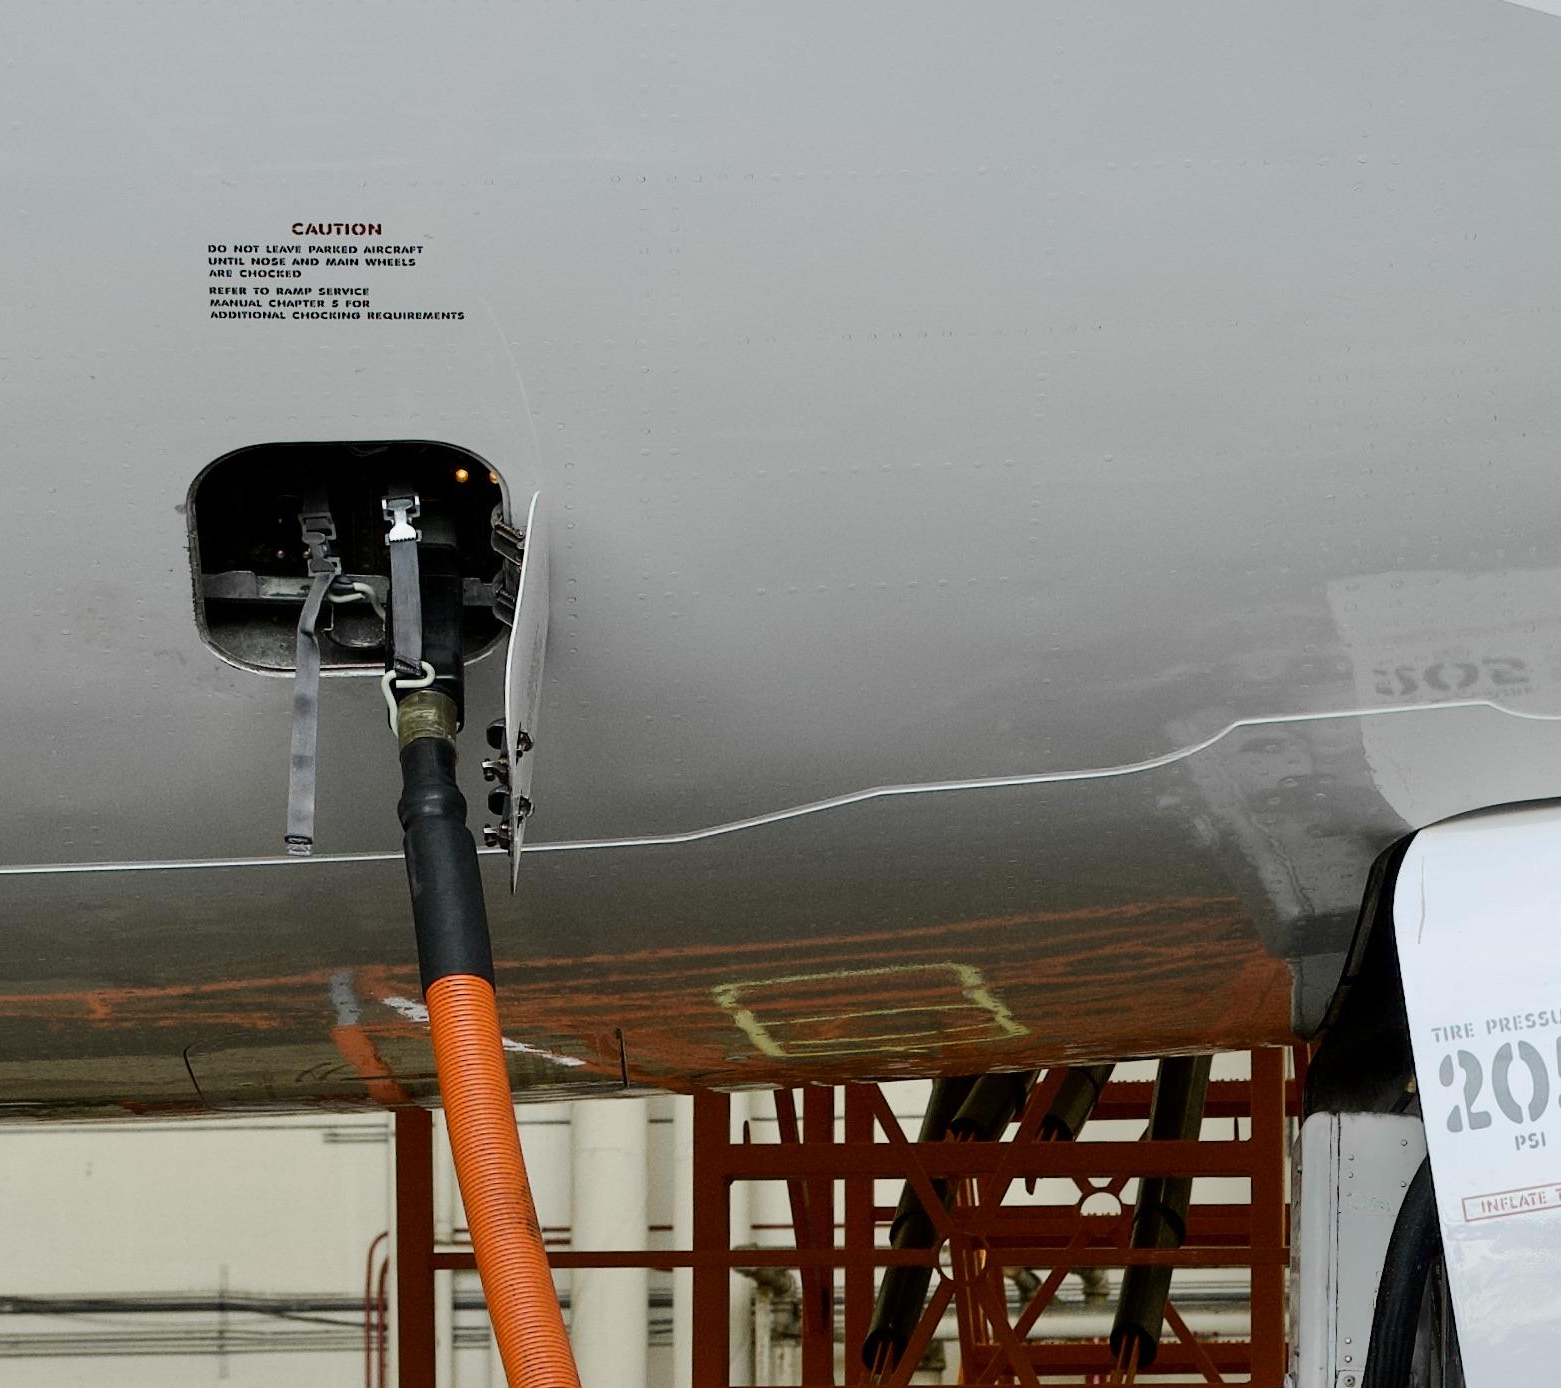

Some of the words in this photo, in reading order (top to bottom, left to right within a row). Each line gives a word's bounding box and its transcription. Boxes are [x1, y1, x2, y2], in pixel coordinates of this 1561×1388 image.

[291, 222, 383, 236] CAUTION
[207, 244, 227, 254] DO
[233, 244, 260, 254] NOT
[265, 245, 302, 254] LEAVE
[308, 245, 358, 254] PARKED
[363, 245, 424, 254] AIRCRAFT
[208, 257, 245, 266] UNTIL
[251, 257, 286, 266] NOSE
[291, 258, 320, 266] AND
[325, 258, 359, 266] MAIN
[364, 258, 416, 267] WHEELS
[208, 269, 233, 278] ARE
[239, 270, 302, 279] CHOCKED
[208, 286, 247, 296] REFER
[252, 287, 270, 295] TO
[275, 287, 313, 296] RAMP
[318, 287, 370, 296] SERVICE
[209, 299, 263, 308] MANUAL
[268, 300, 325, 308] CHAPTER
[331, 300, 339, 308] 5
[345, 300, 371, 308] FOR
[210, 311, 286, 320] ADDITIONAL
[291, 311, 361, 320] CHOCKING
[366, 311, 466, 320] REQUIREMENTS
[1430, 1022, 1475, 1044] TIRE
[1514, 1131, 1547, 1151] PSI
[1480, 1191, 1548, 1214] INFLATE
